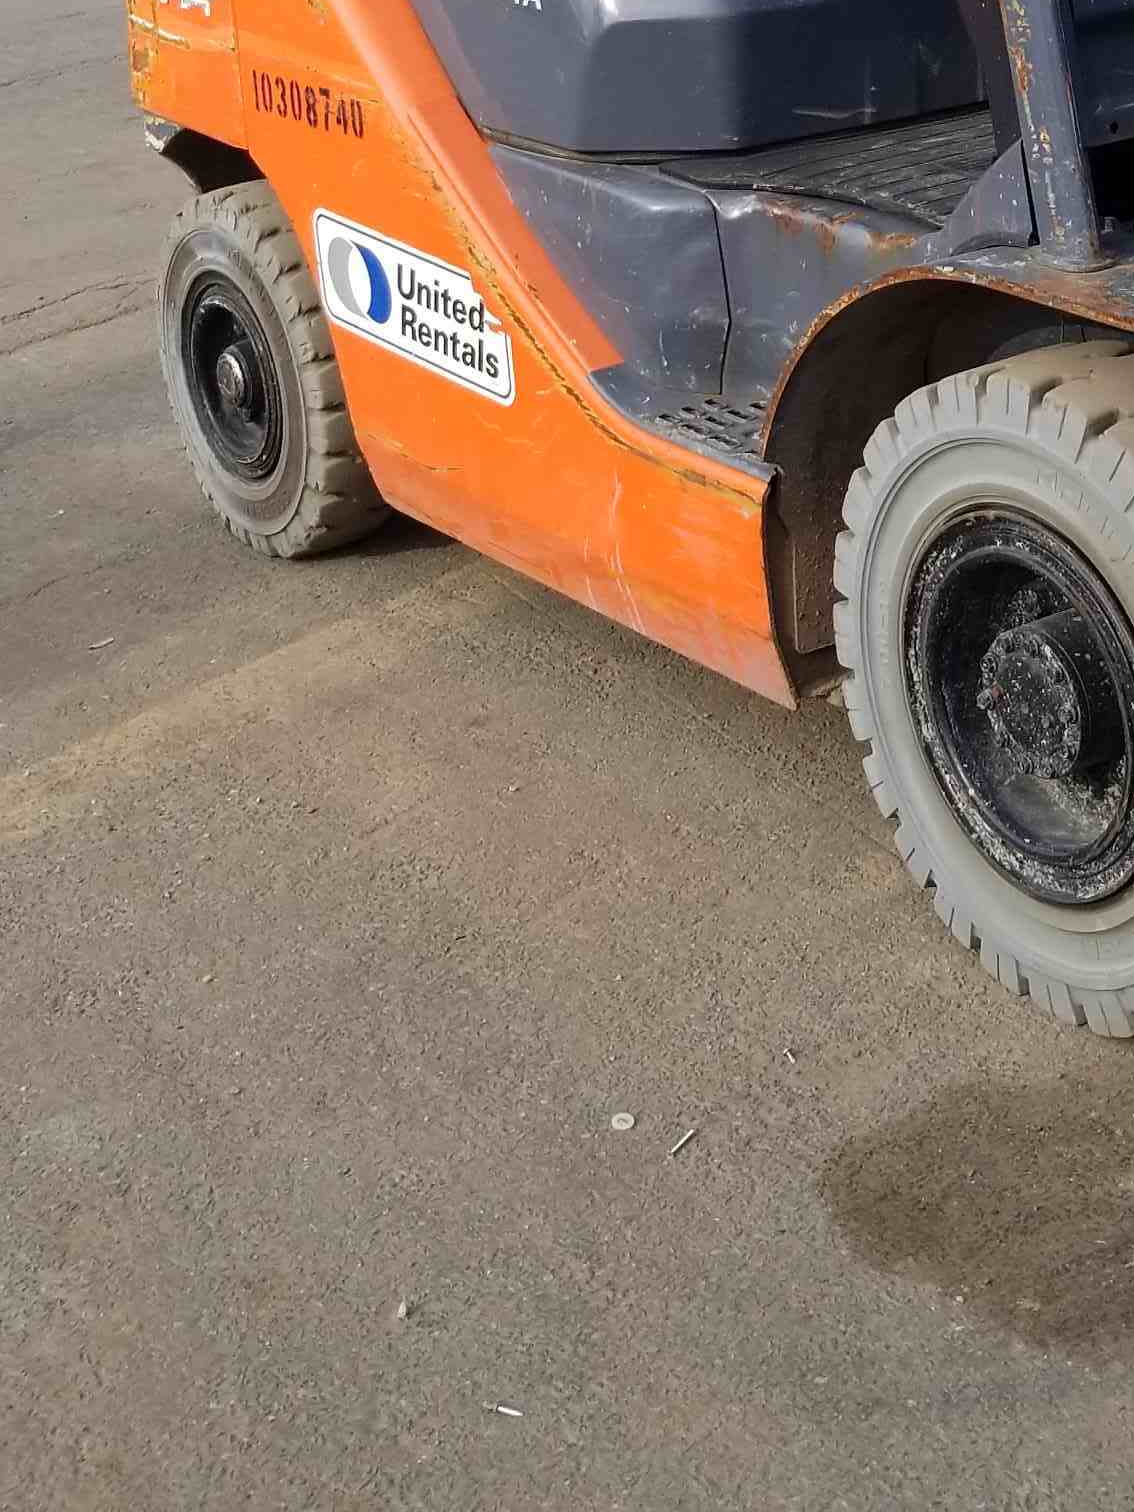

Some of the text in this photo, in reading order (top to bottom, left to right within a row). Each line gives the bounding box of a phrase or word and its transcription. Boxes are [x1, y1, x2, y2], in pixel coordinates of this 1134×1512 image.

[252, 69, 365, 139] 10308740
[397, 263, 487, 333] United
[401, 304, 500, 380] Rentals
